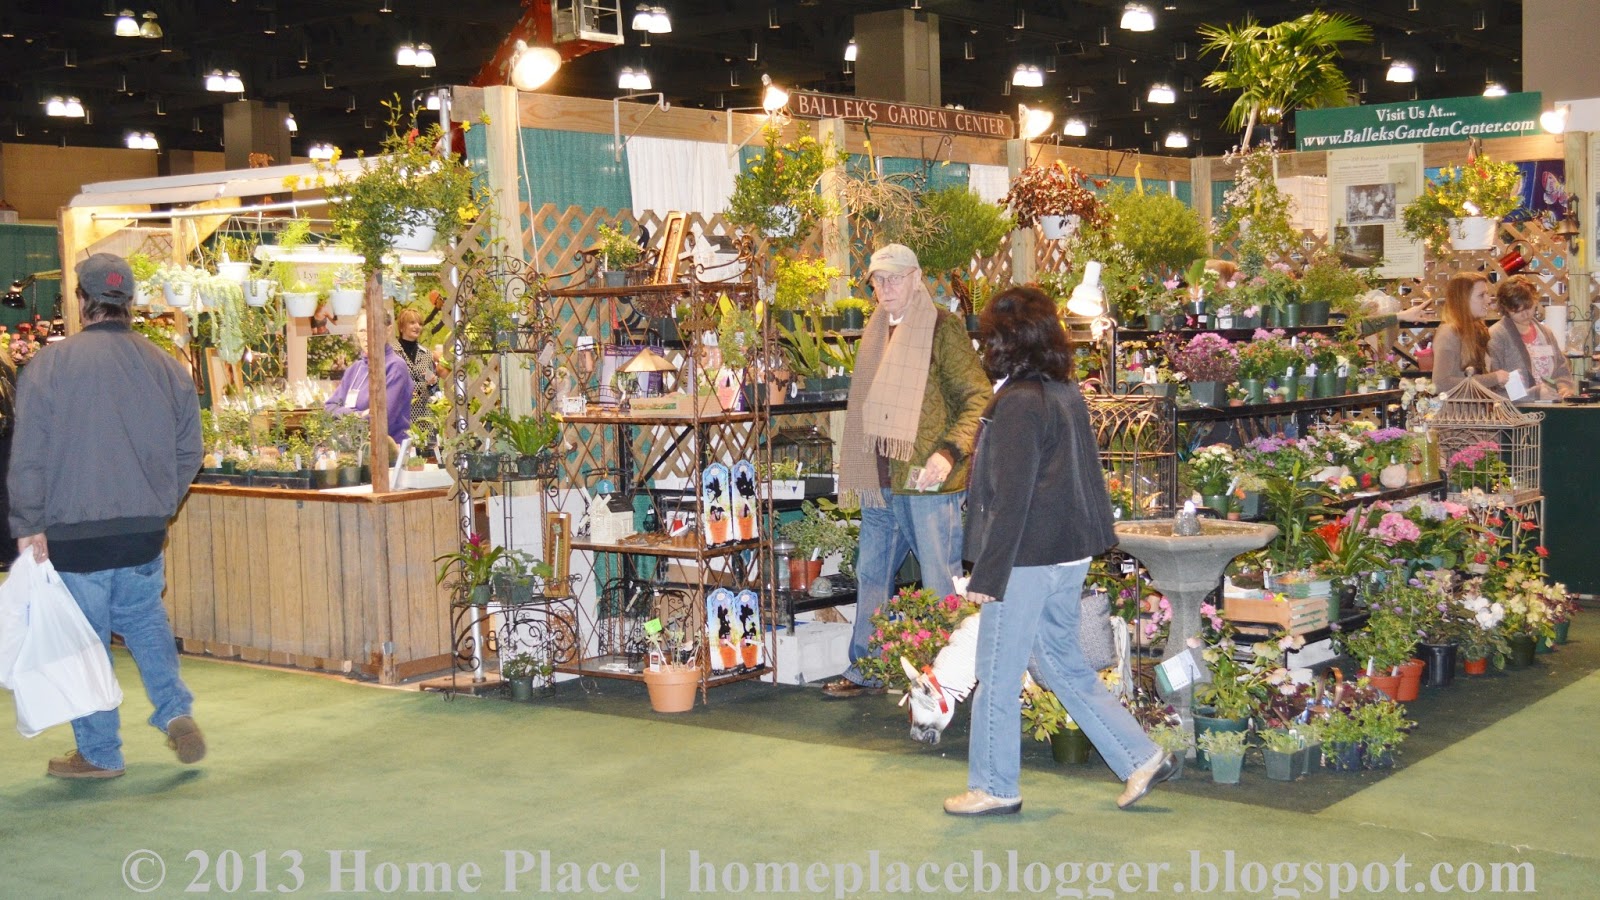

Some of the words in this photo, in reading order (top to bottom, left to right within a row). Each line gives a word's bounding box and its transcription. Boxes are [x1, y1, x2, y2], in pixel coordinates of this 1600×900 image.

[798, 95, 878, 120] BALLEK'S
[888, 104, 948, 128] GARDEN
[955, 113, 1005, 135] CENTER
[1375, 108, 1405, 122] Visit
[1408, 106, 1425, 119] Us
[1303, 120, 1535, 147] www.BalleksGardenCenter.com
